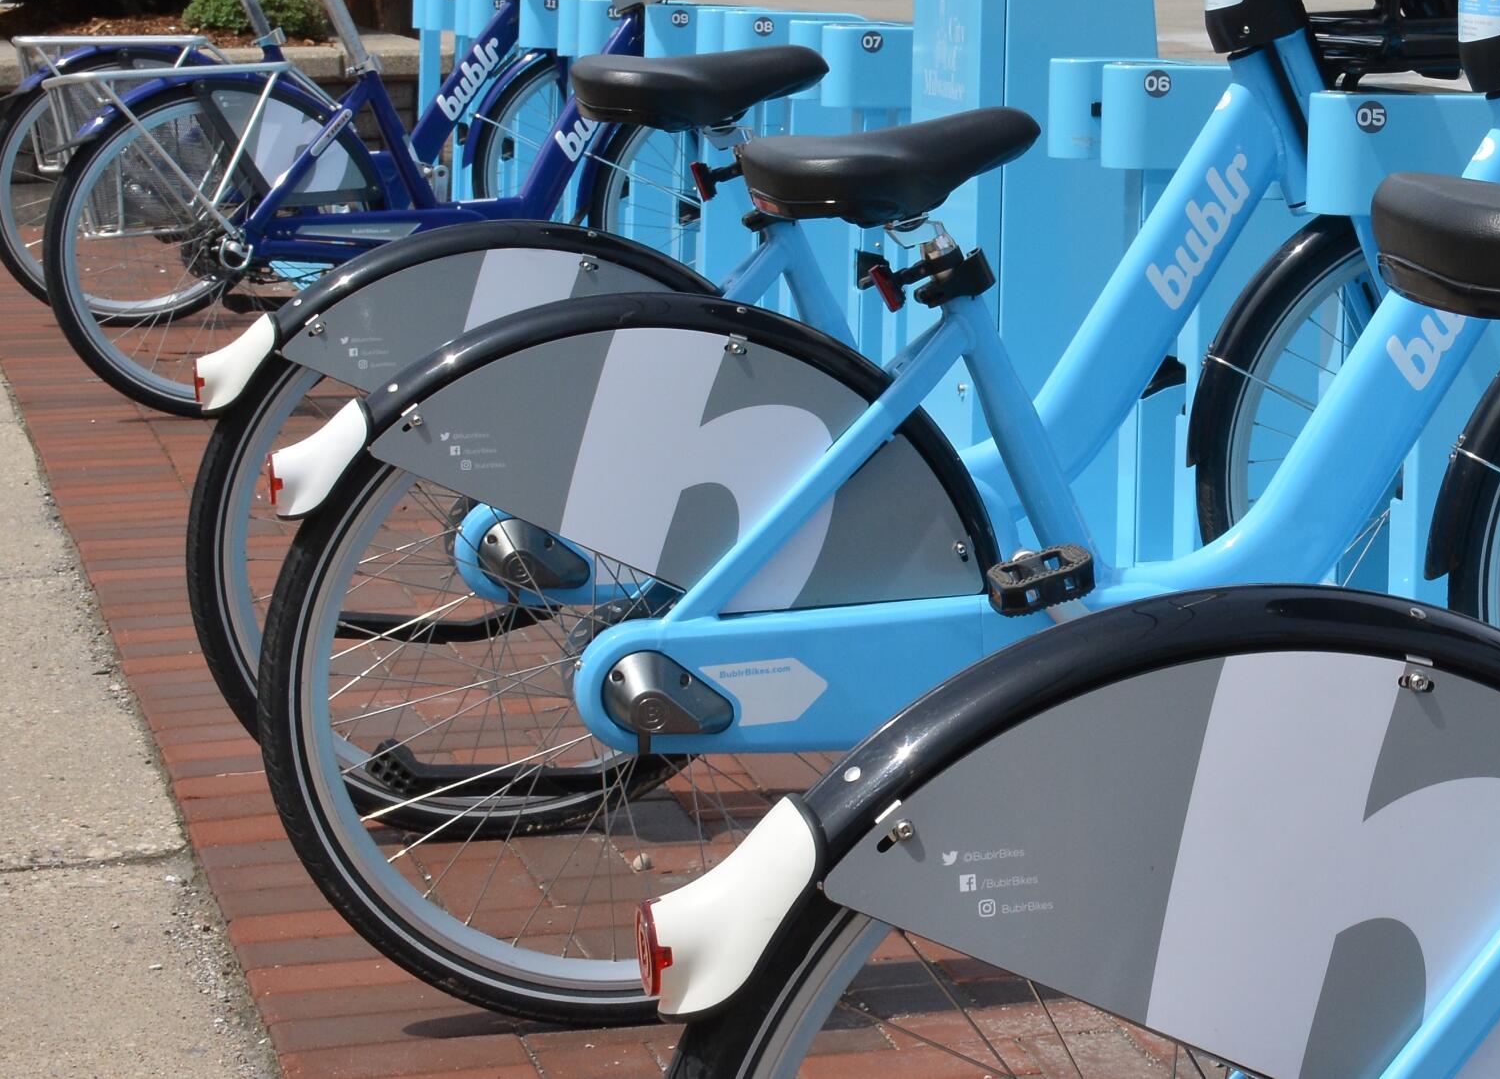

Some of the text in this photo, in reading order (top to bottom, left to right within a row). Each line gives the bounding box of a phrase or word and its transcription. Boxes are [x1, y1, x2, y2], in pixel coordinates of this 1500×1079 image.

[545, 0, 557, 9] 11
[670, 13, 690, 25] 09
[754, 20, 774, 34] 08
[862, 35, 883, 49] 07
[436, 37, 499, 122] bublr
[1144, 75, 1171, 92] 06
[1357, 107, 1386, 126] 05
[1146, 153, 1250, 311] bublr
[719, 665, 791, 679] BublrBikes.com
[1001, 901, 1054, 914] BublrBikes
